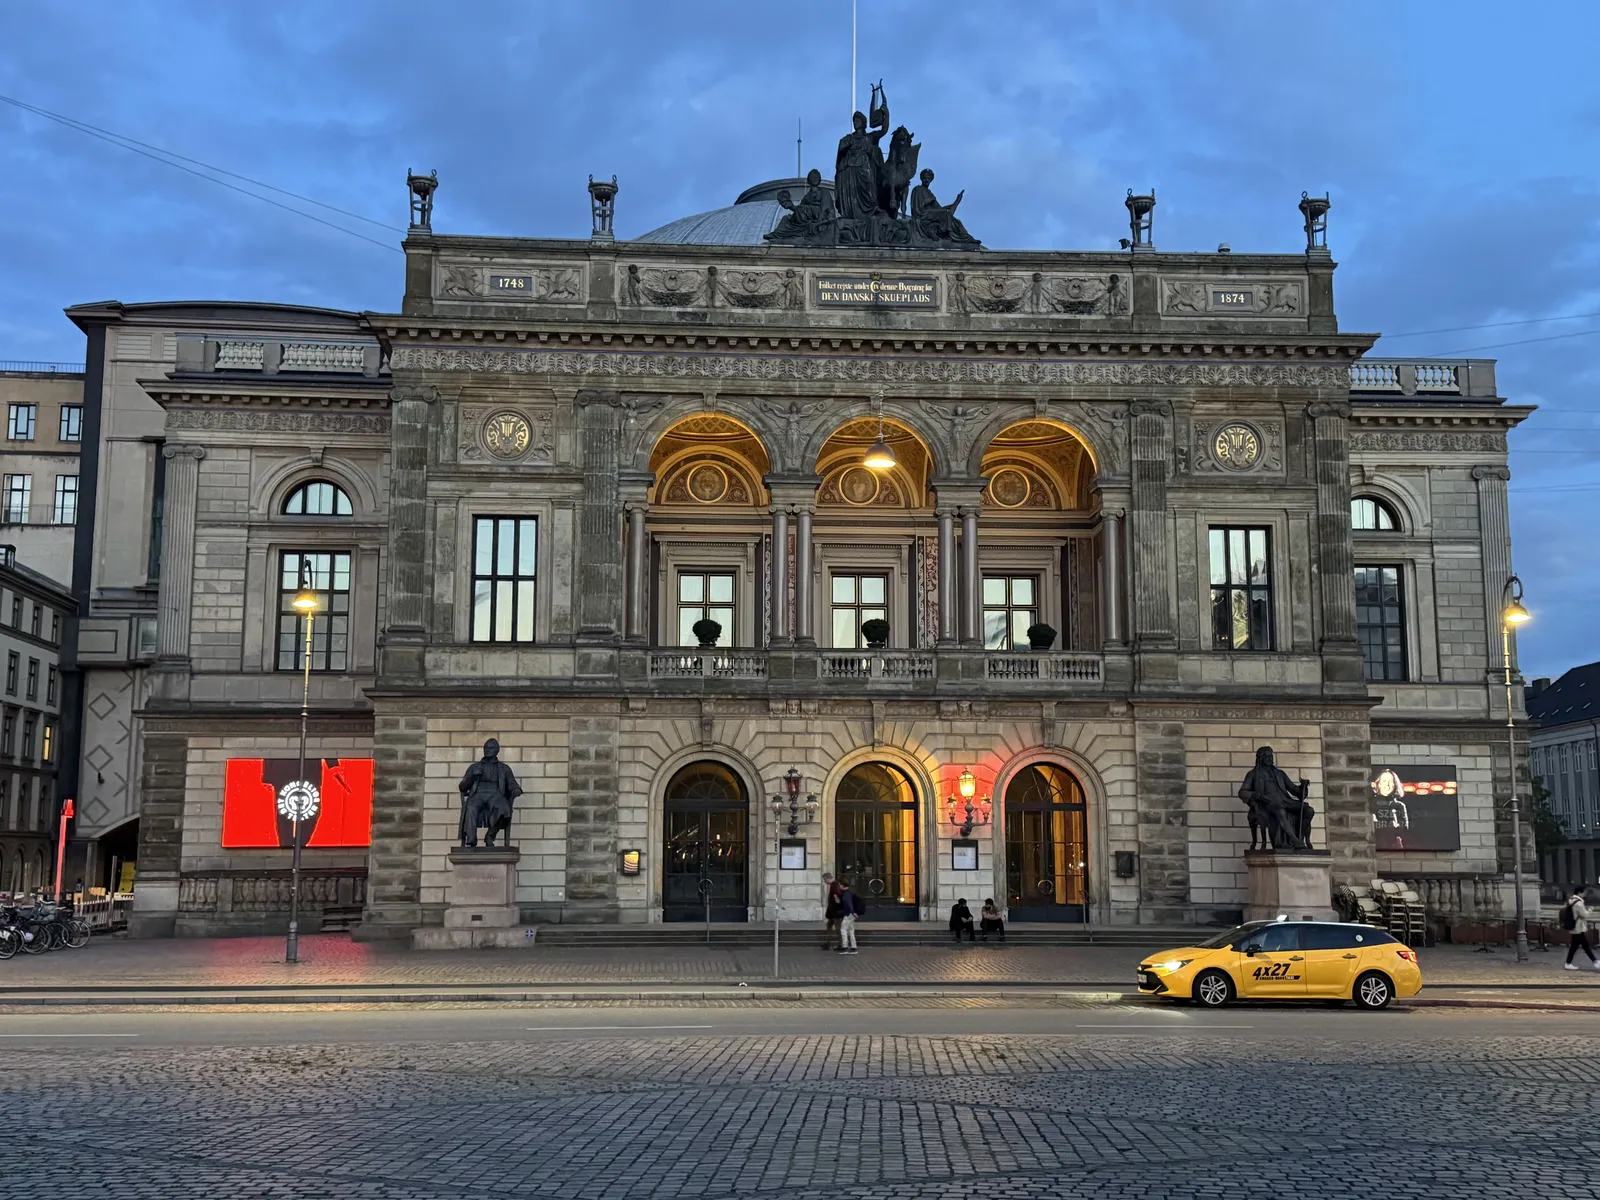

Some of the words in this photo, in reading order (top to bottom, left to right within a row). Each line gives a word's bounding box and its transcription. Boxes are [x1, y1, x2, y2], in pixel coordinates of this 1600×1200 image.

[499, 278, 524, 288] 1748
[821, 291, 840, 301] DEN
[842, 292, 876, 302] DANSKE
[878, 293, 931, 303] SKUEPLADS
[1221, 293, 1245, 303] 1874
